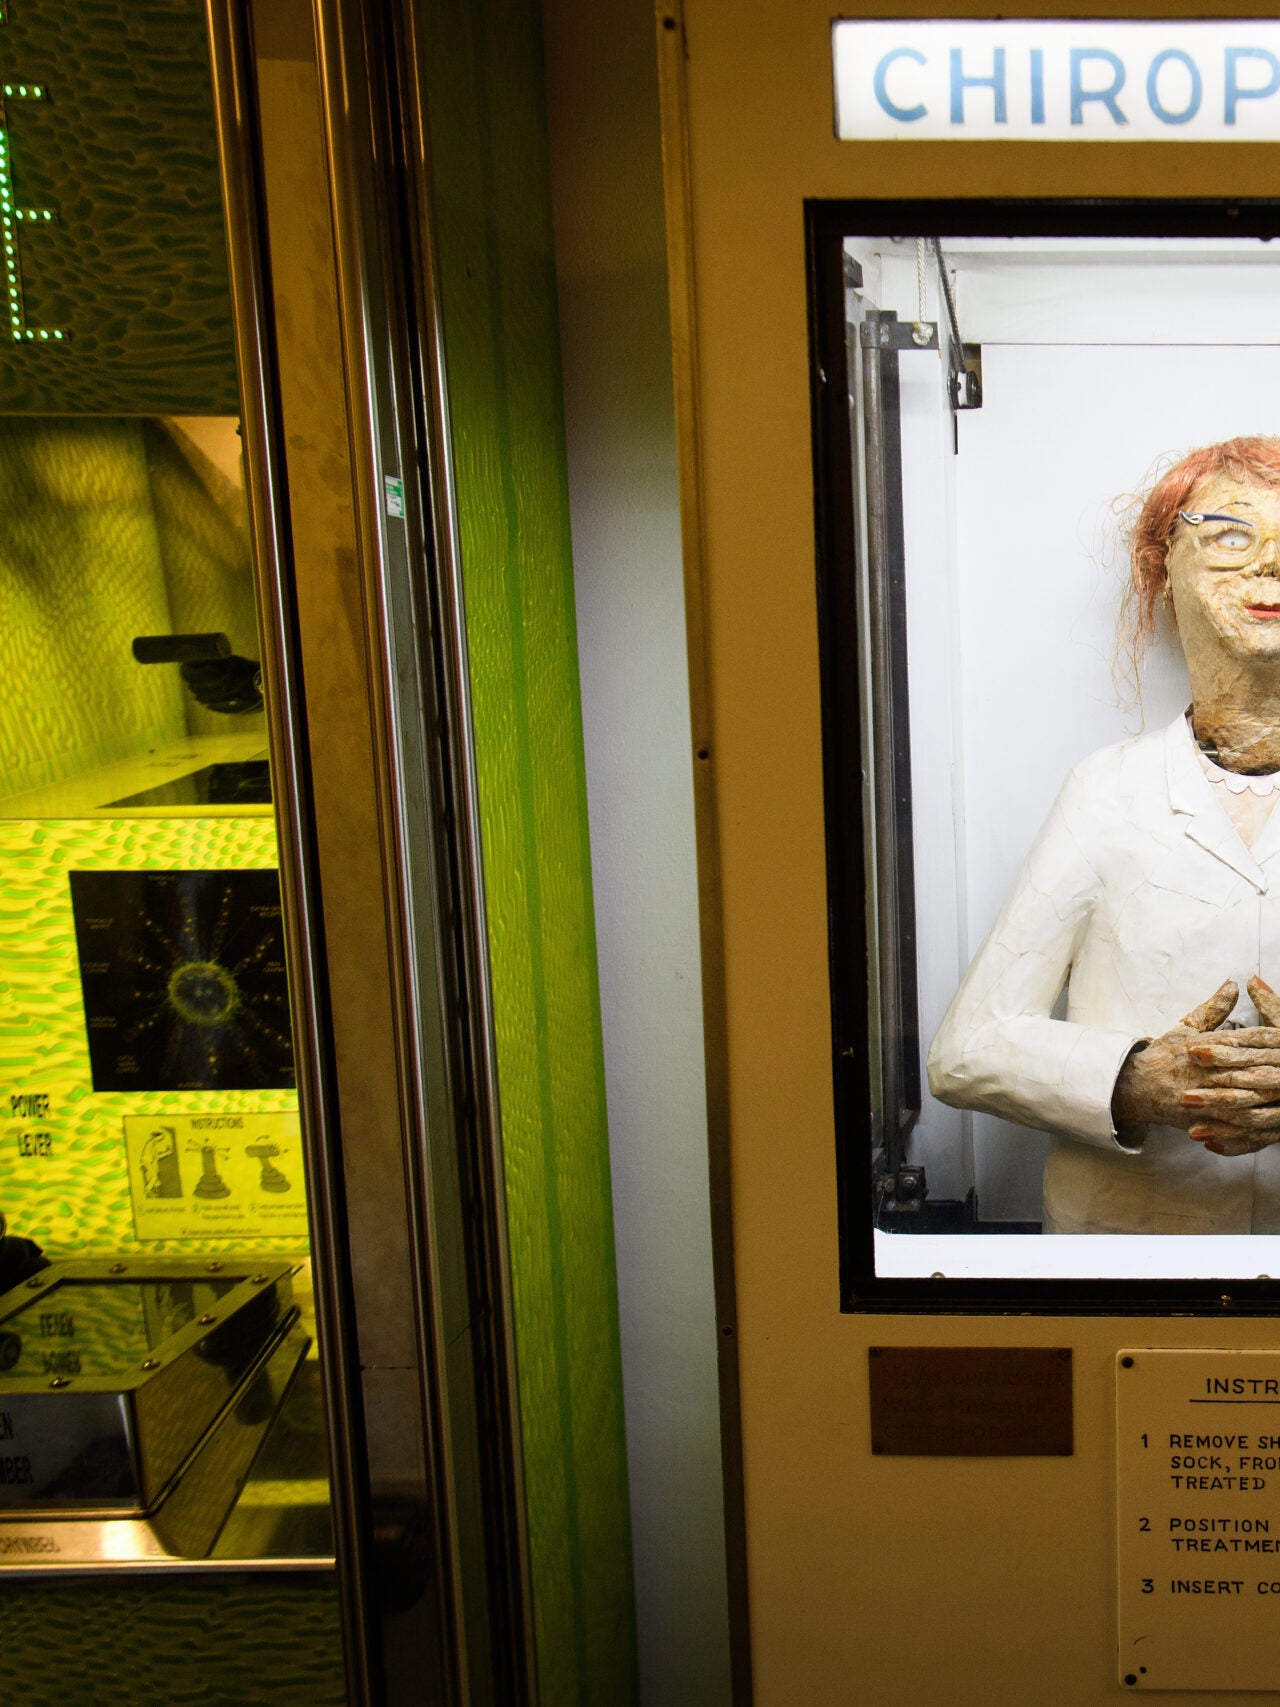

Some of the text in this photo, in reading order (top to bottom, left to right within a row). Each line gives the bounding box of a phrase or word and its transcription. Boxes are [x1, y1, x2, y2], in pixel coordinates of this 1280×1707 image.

[1140, 1433, 1149, 1449] 1
[1169, 1434, 1249, 1450] REMOVE
[1170, 1456, 1231, 1473] SOCK,
[1171, 1475, 1266, 1490] TREATED
[1138, 1517, 1152, 1532] 2
[1169, 1518, 1269, 1533] POSITION
[1141, 1579, 1155, 1594] 3
[1170, 1580, 1244, 1595] INSERT
